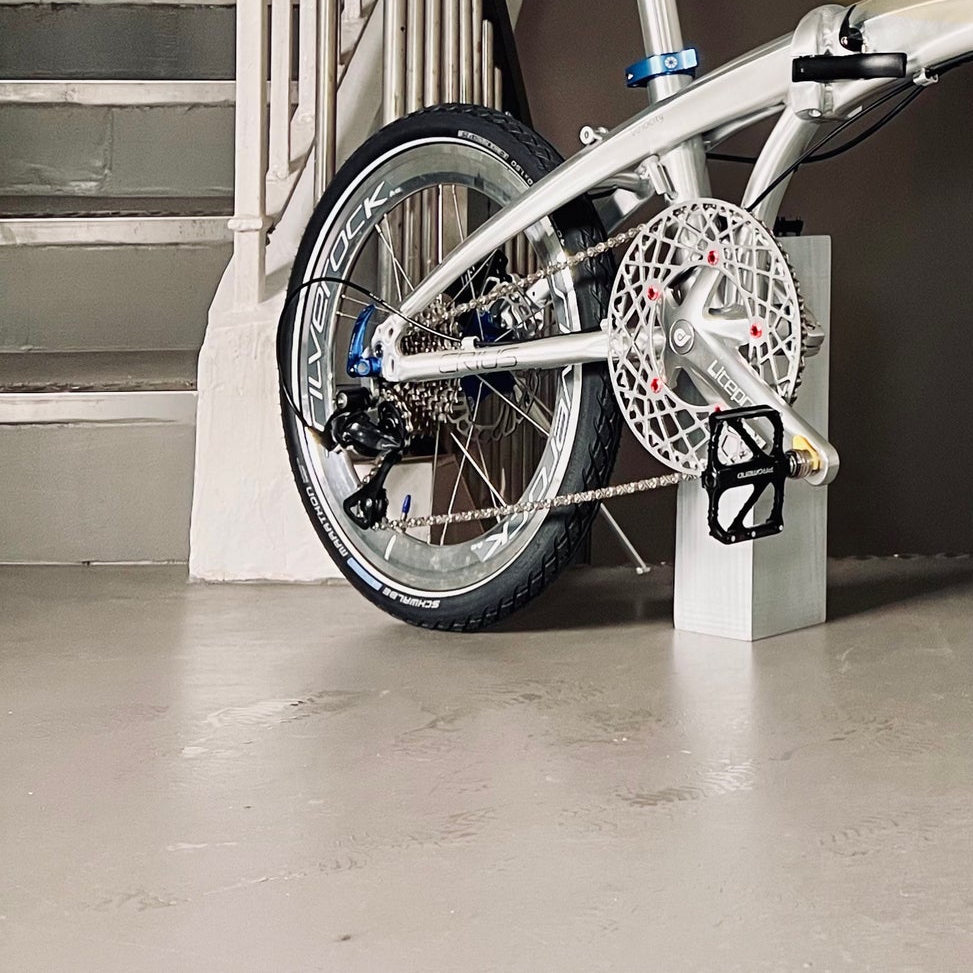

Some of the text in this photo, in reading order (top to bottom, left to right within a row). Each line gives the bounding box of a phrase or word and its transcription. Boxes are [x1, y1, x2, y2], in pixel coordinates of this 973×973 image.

[439, 346, 519, 374] CRIUS
[707, 359, 757, 407] Litepr
[382, 586, 441, 610] SCHWALBE
